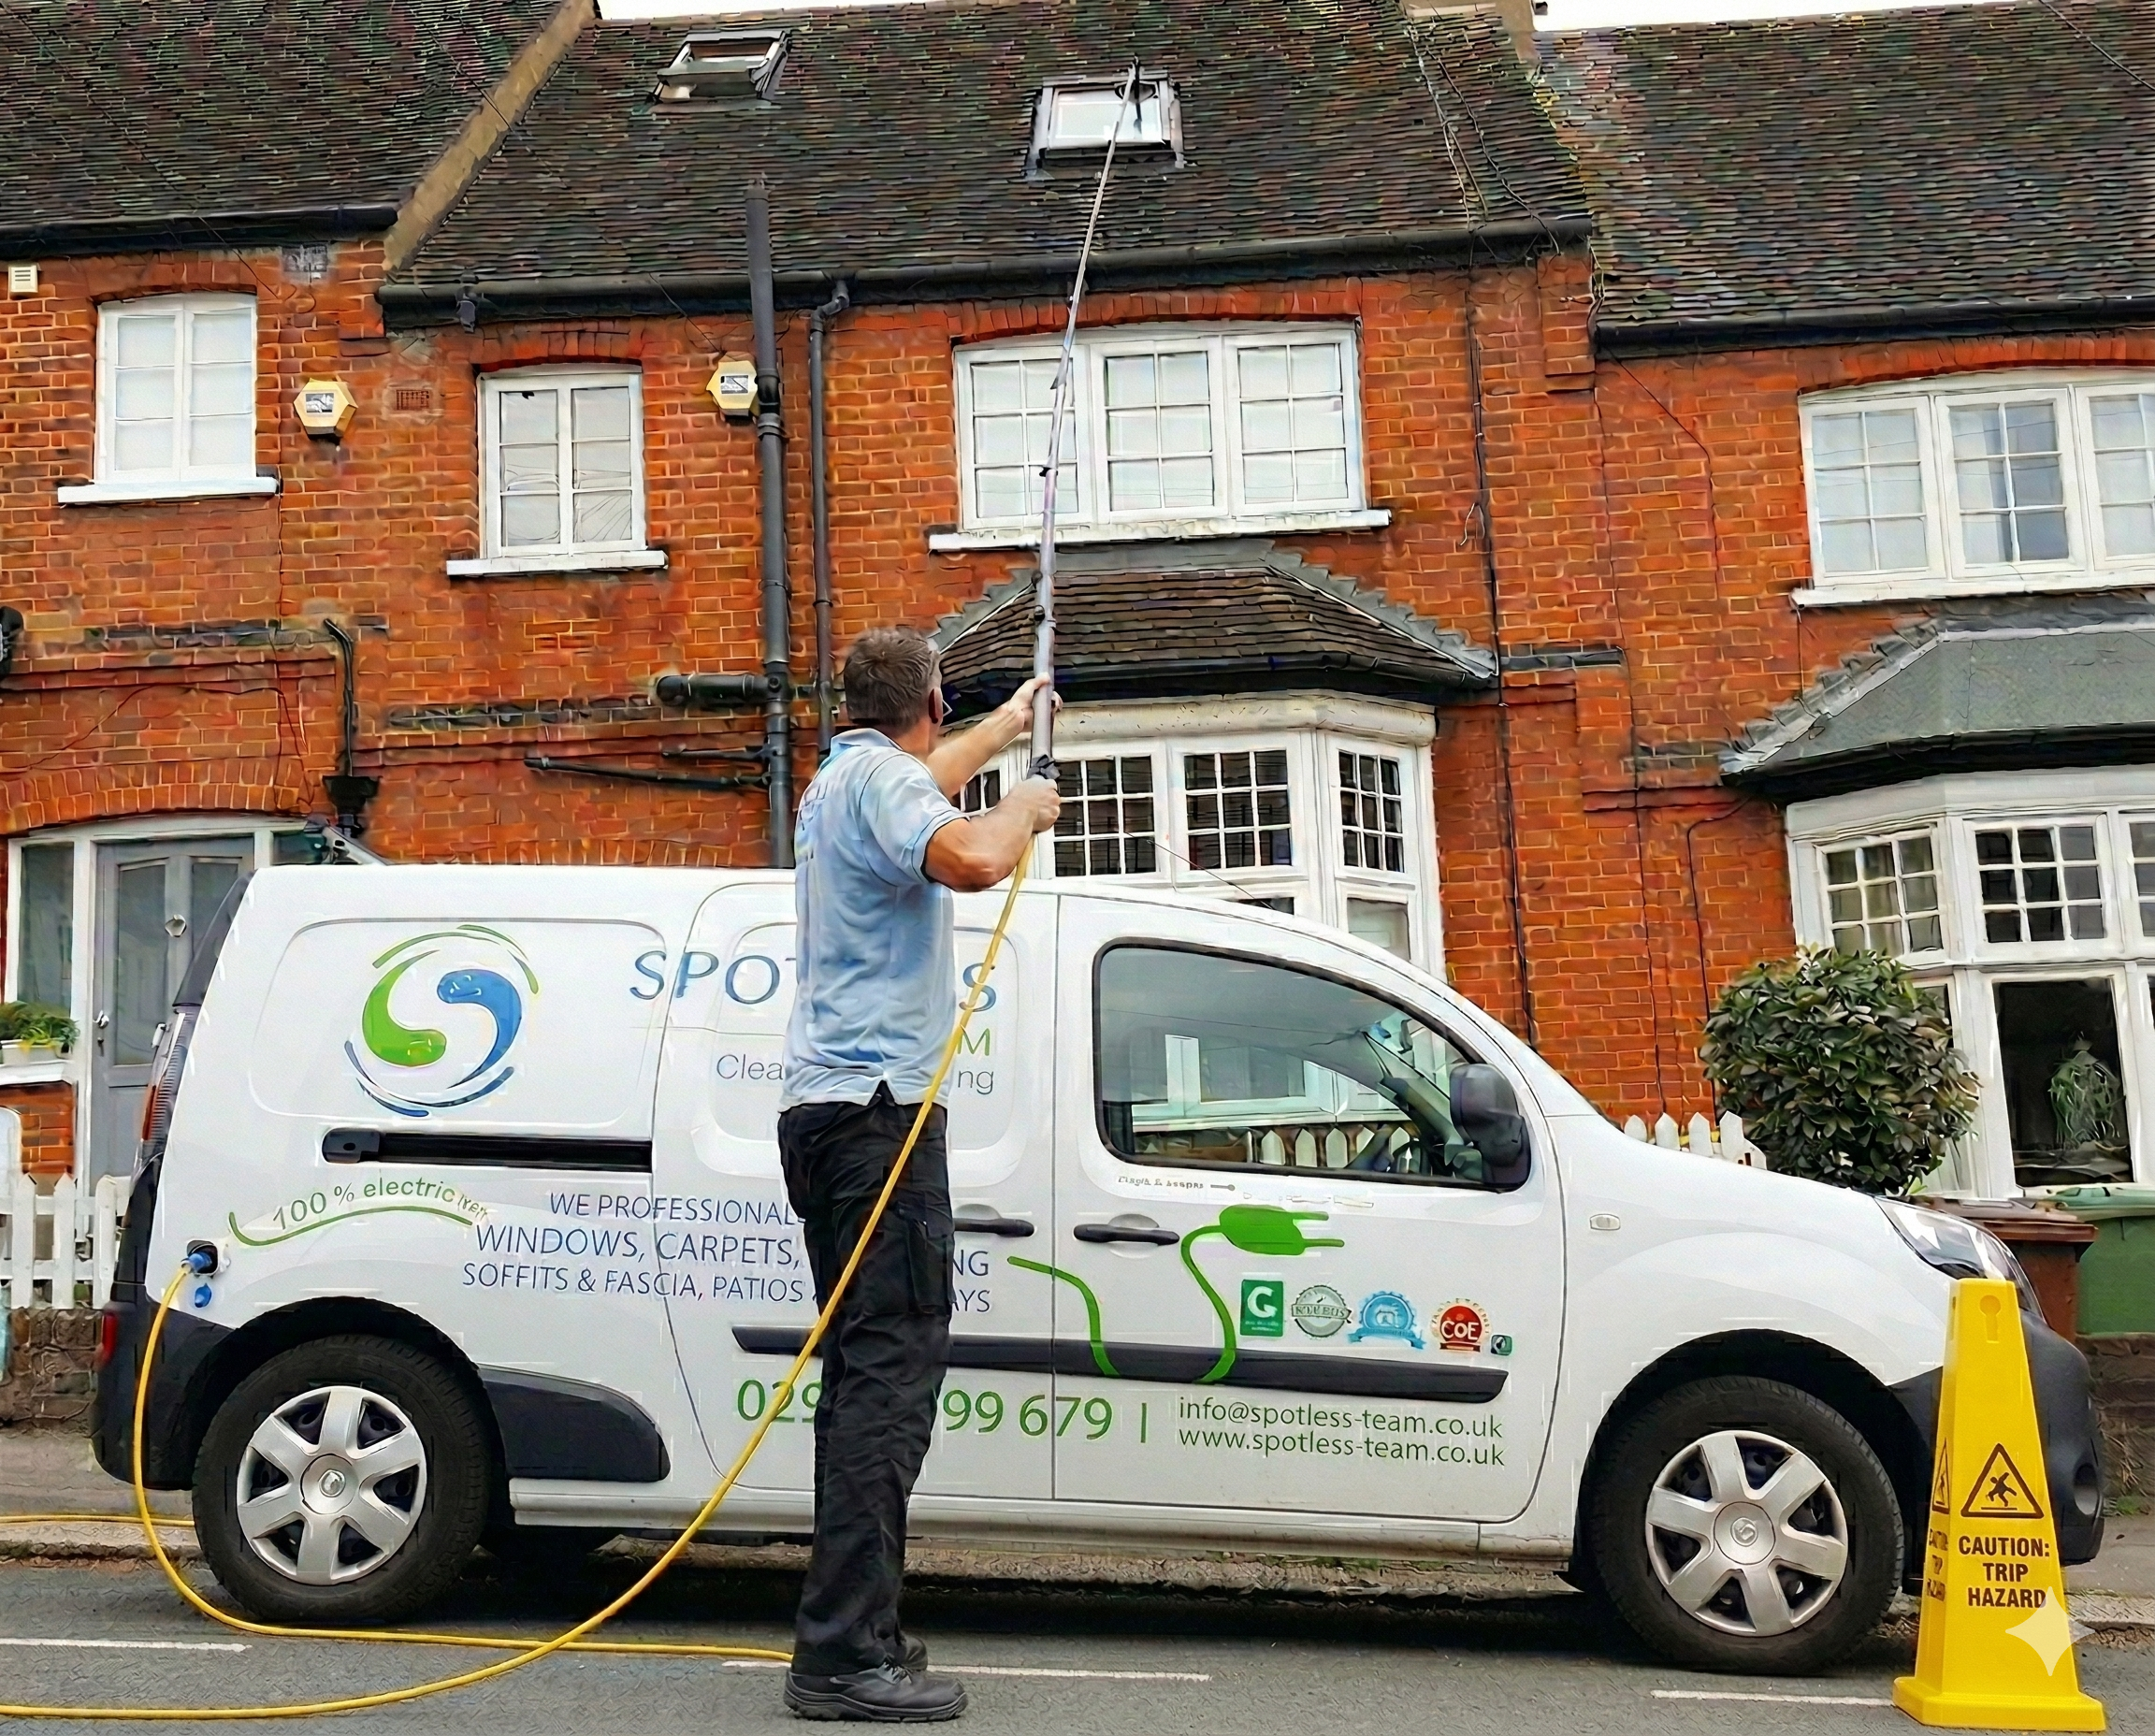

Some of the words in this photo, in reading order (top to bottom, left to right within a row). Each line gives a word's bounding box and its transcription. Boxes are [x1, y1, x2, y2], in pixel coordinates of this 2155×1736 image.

[629, 949, 997, 1012] SPOS
[716, 1053, 783, 1081] Clea
[273, 1192, 326, 1231] 100
[334, 1181, 355, 1207] %
[363, 1177, 456, 1204] electric
[550, 1193, 591, 1216] WE
[598, 1194, 799, 1225] PROFESSIONAL
[476, 1223, 644, 1263] WINDOWS,
[657, 1233, 800, 1270] CARPETS,
[463, 1263, 569, 1291] SOFFITS
[577, 1268, 597, 1293] &
[604, 1269, 702, 1301] FASCIA,
[713, 1275, 804, 1303] PATIOS
[1441, 1320, 1480, 1340] COE
[943, 1389, 1004, 1434] 99
[1020, 1394, 1113, 1440] 679
[1179, 1396, 1503, 1439] info@spotless-team.co.uk
[1179, 1429, 1505, 1467] www.spotless-team.co.uk
[1959, 1535, 2050, 1557] CAUTION:
[1983, 1562, 2029, 1583] TRIP
[1968, 1587, 2047, 1609] HAZARD
